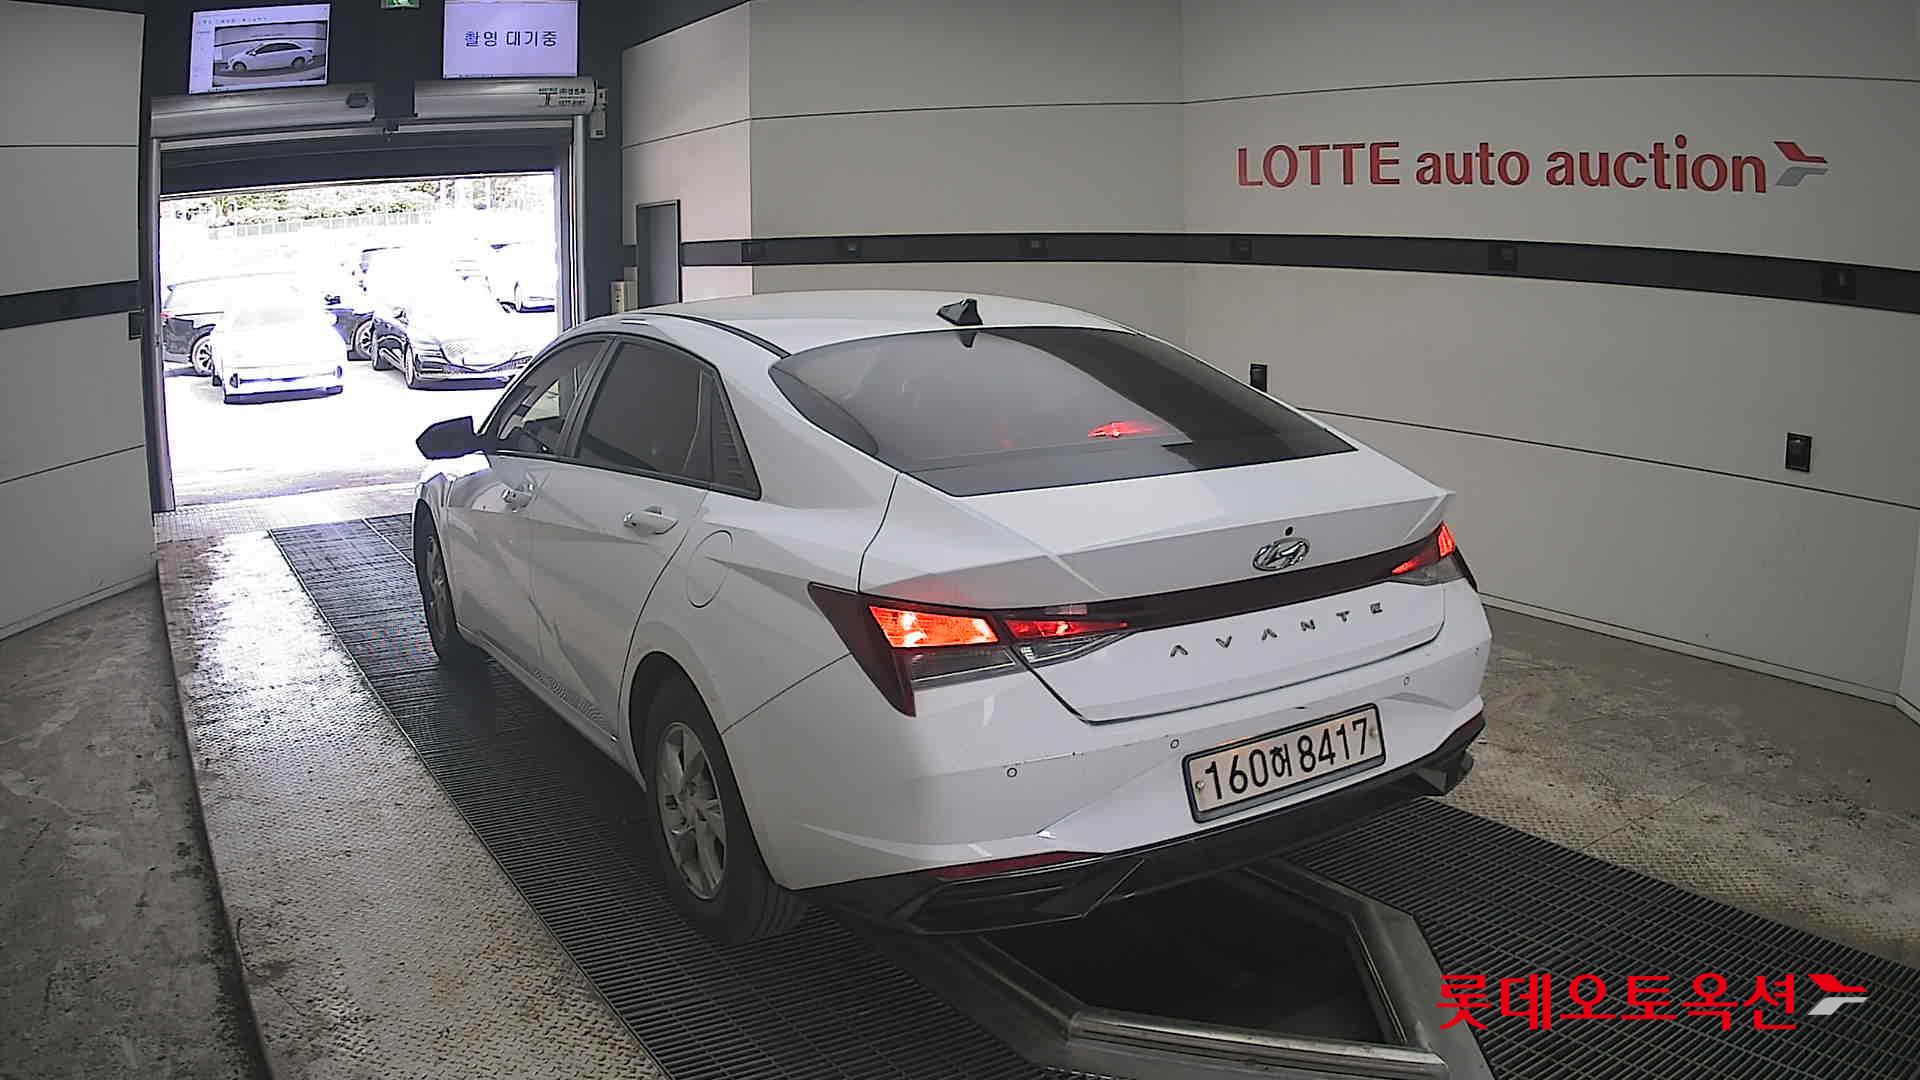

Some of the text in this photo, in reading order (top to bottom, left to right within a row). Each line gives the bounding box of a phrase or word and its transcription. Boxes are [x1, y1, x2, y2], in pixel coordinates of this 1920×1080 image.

[464, 30, 558, 48] 촬영 대기중
[1237, 133, 1768, 194] LOTTE auto auction
[1170, 602, 1383, 658] AVANTE
